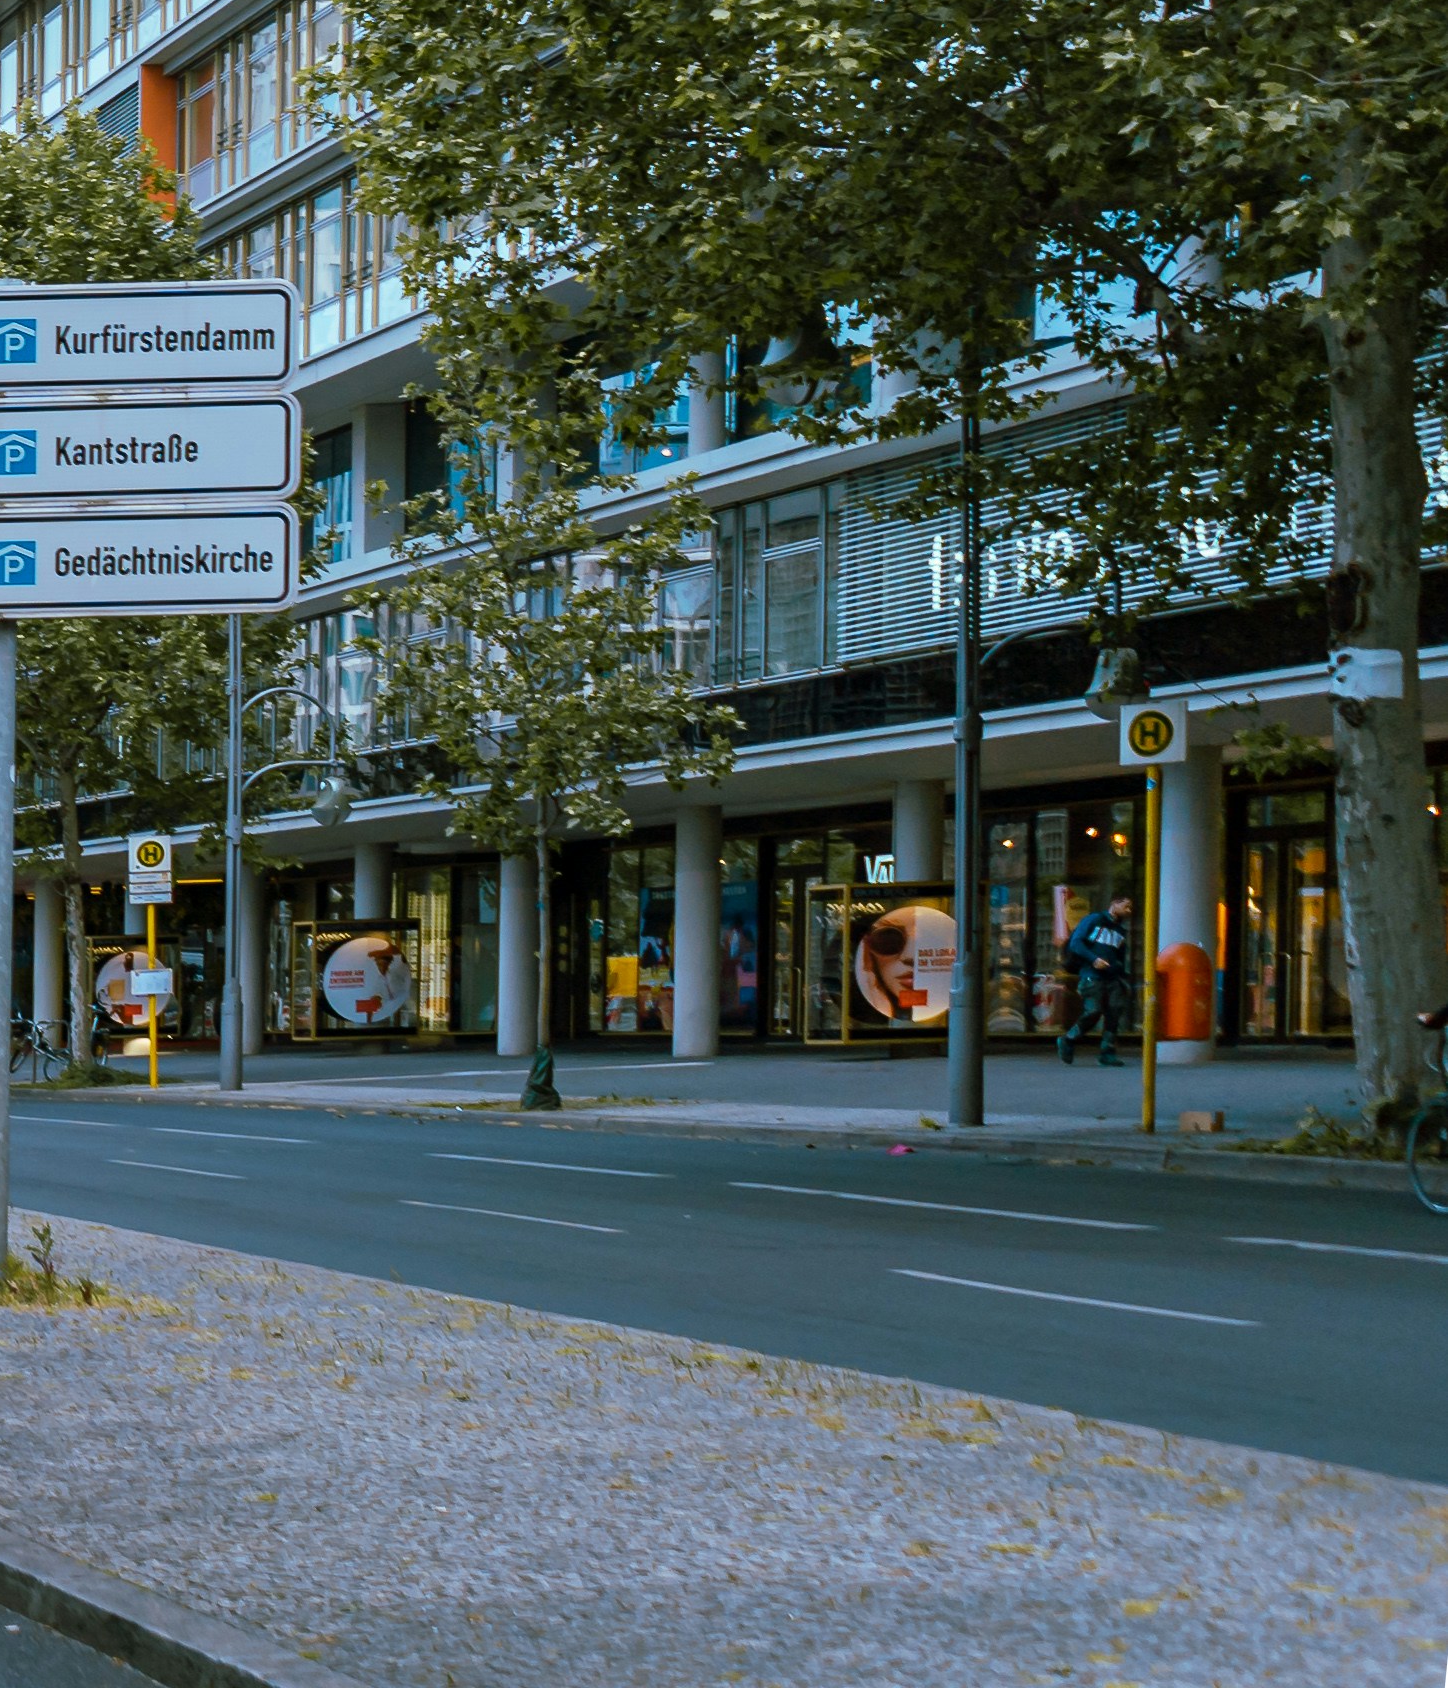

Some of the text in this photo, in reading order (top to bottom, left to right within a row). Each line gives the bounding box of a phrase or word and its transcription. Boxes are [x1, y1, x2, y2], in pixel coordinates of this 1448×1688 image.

[55, 322, 275, 356] Kurfürstendamm
[55, 433, 199, 466] Kantstraße
[55, 543, 274, 577] Gedächtniskirche
[1140, 721, 1161, 746] H
